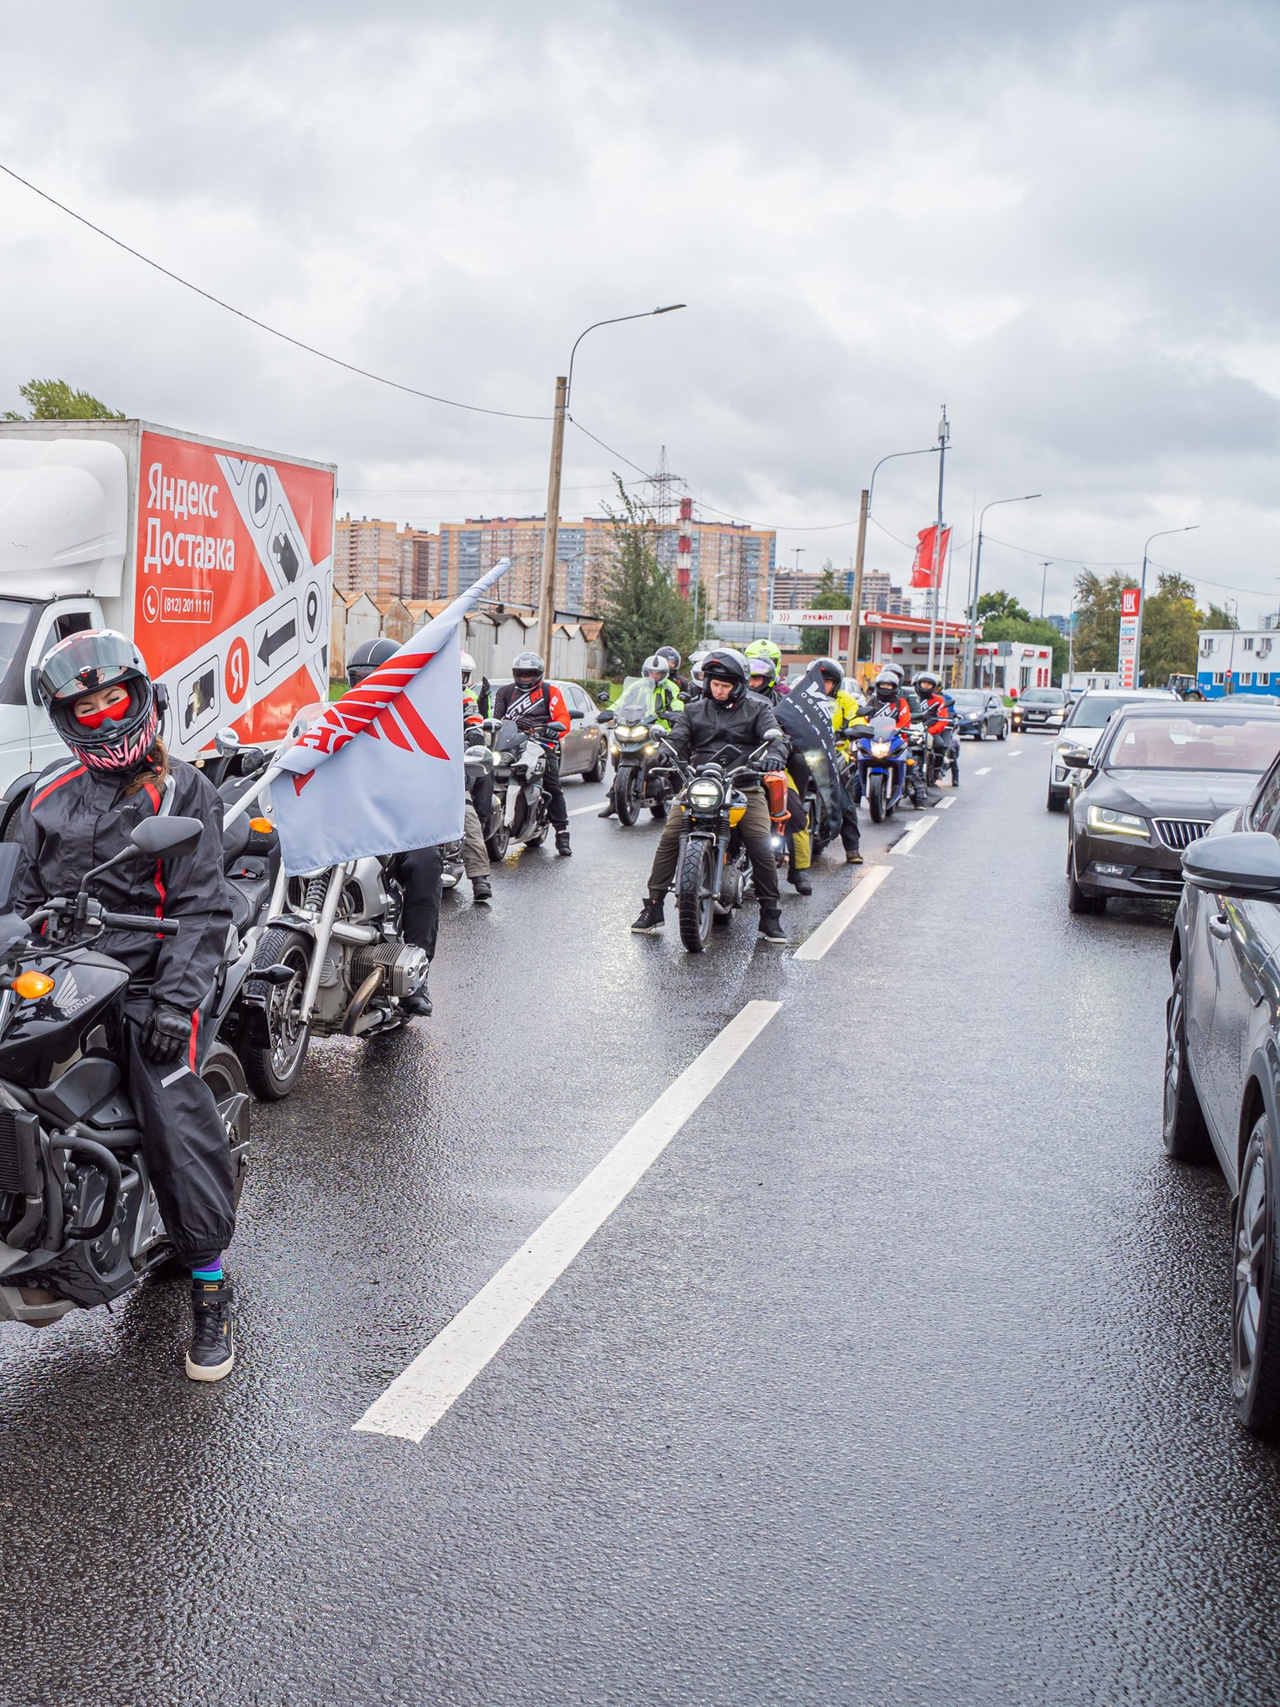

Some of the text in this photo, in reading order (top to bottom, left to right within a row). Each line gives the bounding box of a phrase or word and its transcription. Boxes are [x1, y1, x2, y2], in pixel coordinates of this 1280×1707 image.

[147, 462, 219, 519] Яндекс
[143, 517, 235, 574] Доставка
[164, 597, 210, 614] (812) 201 11 11
[62, 994, 96, 1017] HONDA
